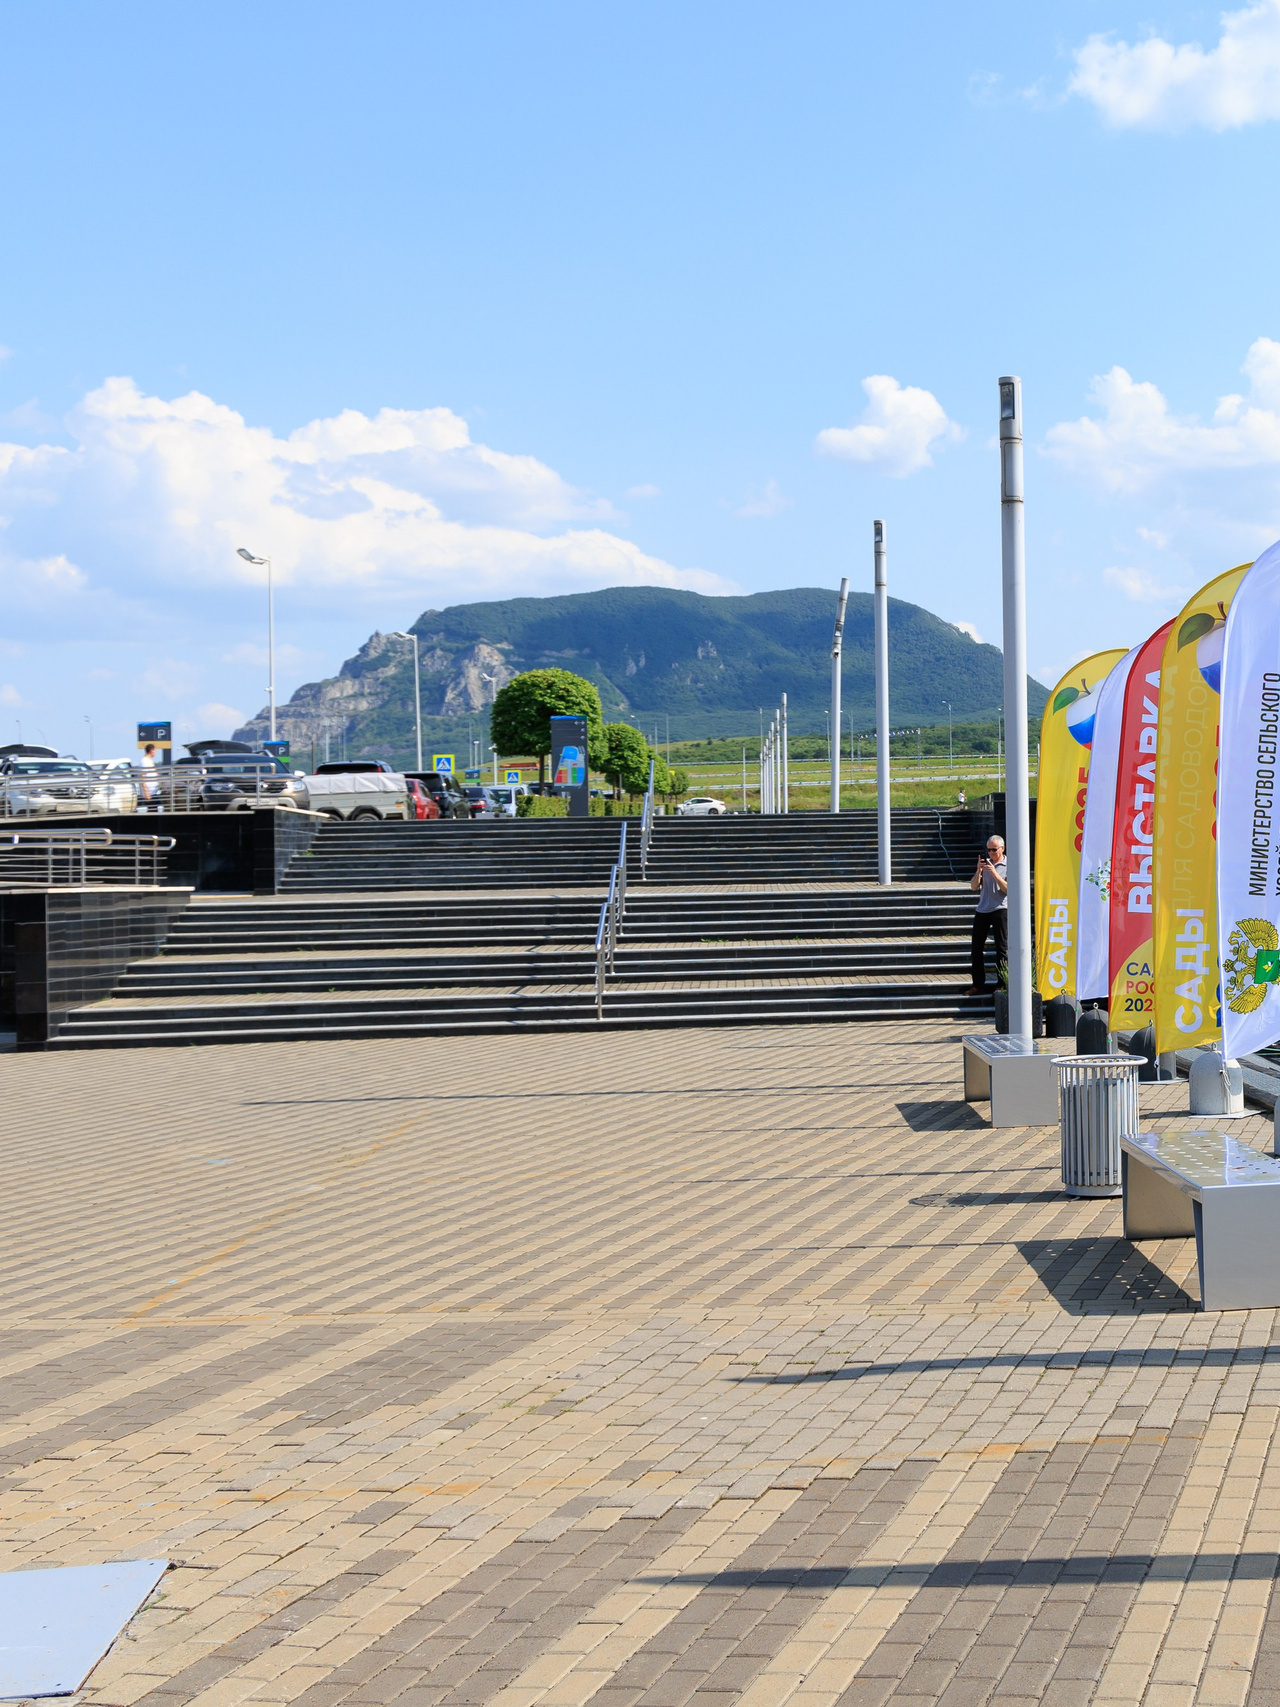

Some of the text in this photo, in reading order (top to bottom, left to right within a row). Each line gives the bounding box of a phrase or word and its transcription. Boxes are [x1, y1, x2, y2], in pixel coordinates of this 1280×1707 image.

[157, 729, 167, 739] P
[1248, 769, 1275, 896] МИНИСТЕРСТВО
[1048, 898, 1073, 988] САДЫ
[1174, 908, 1211, 1033] САДЫ
